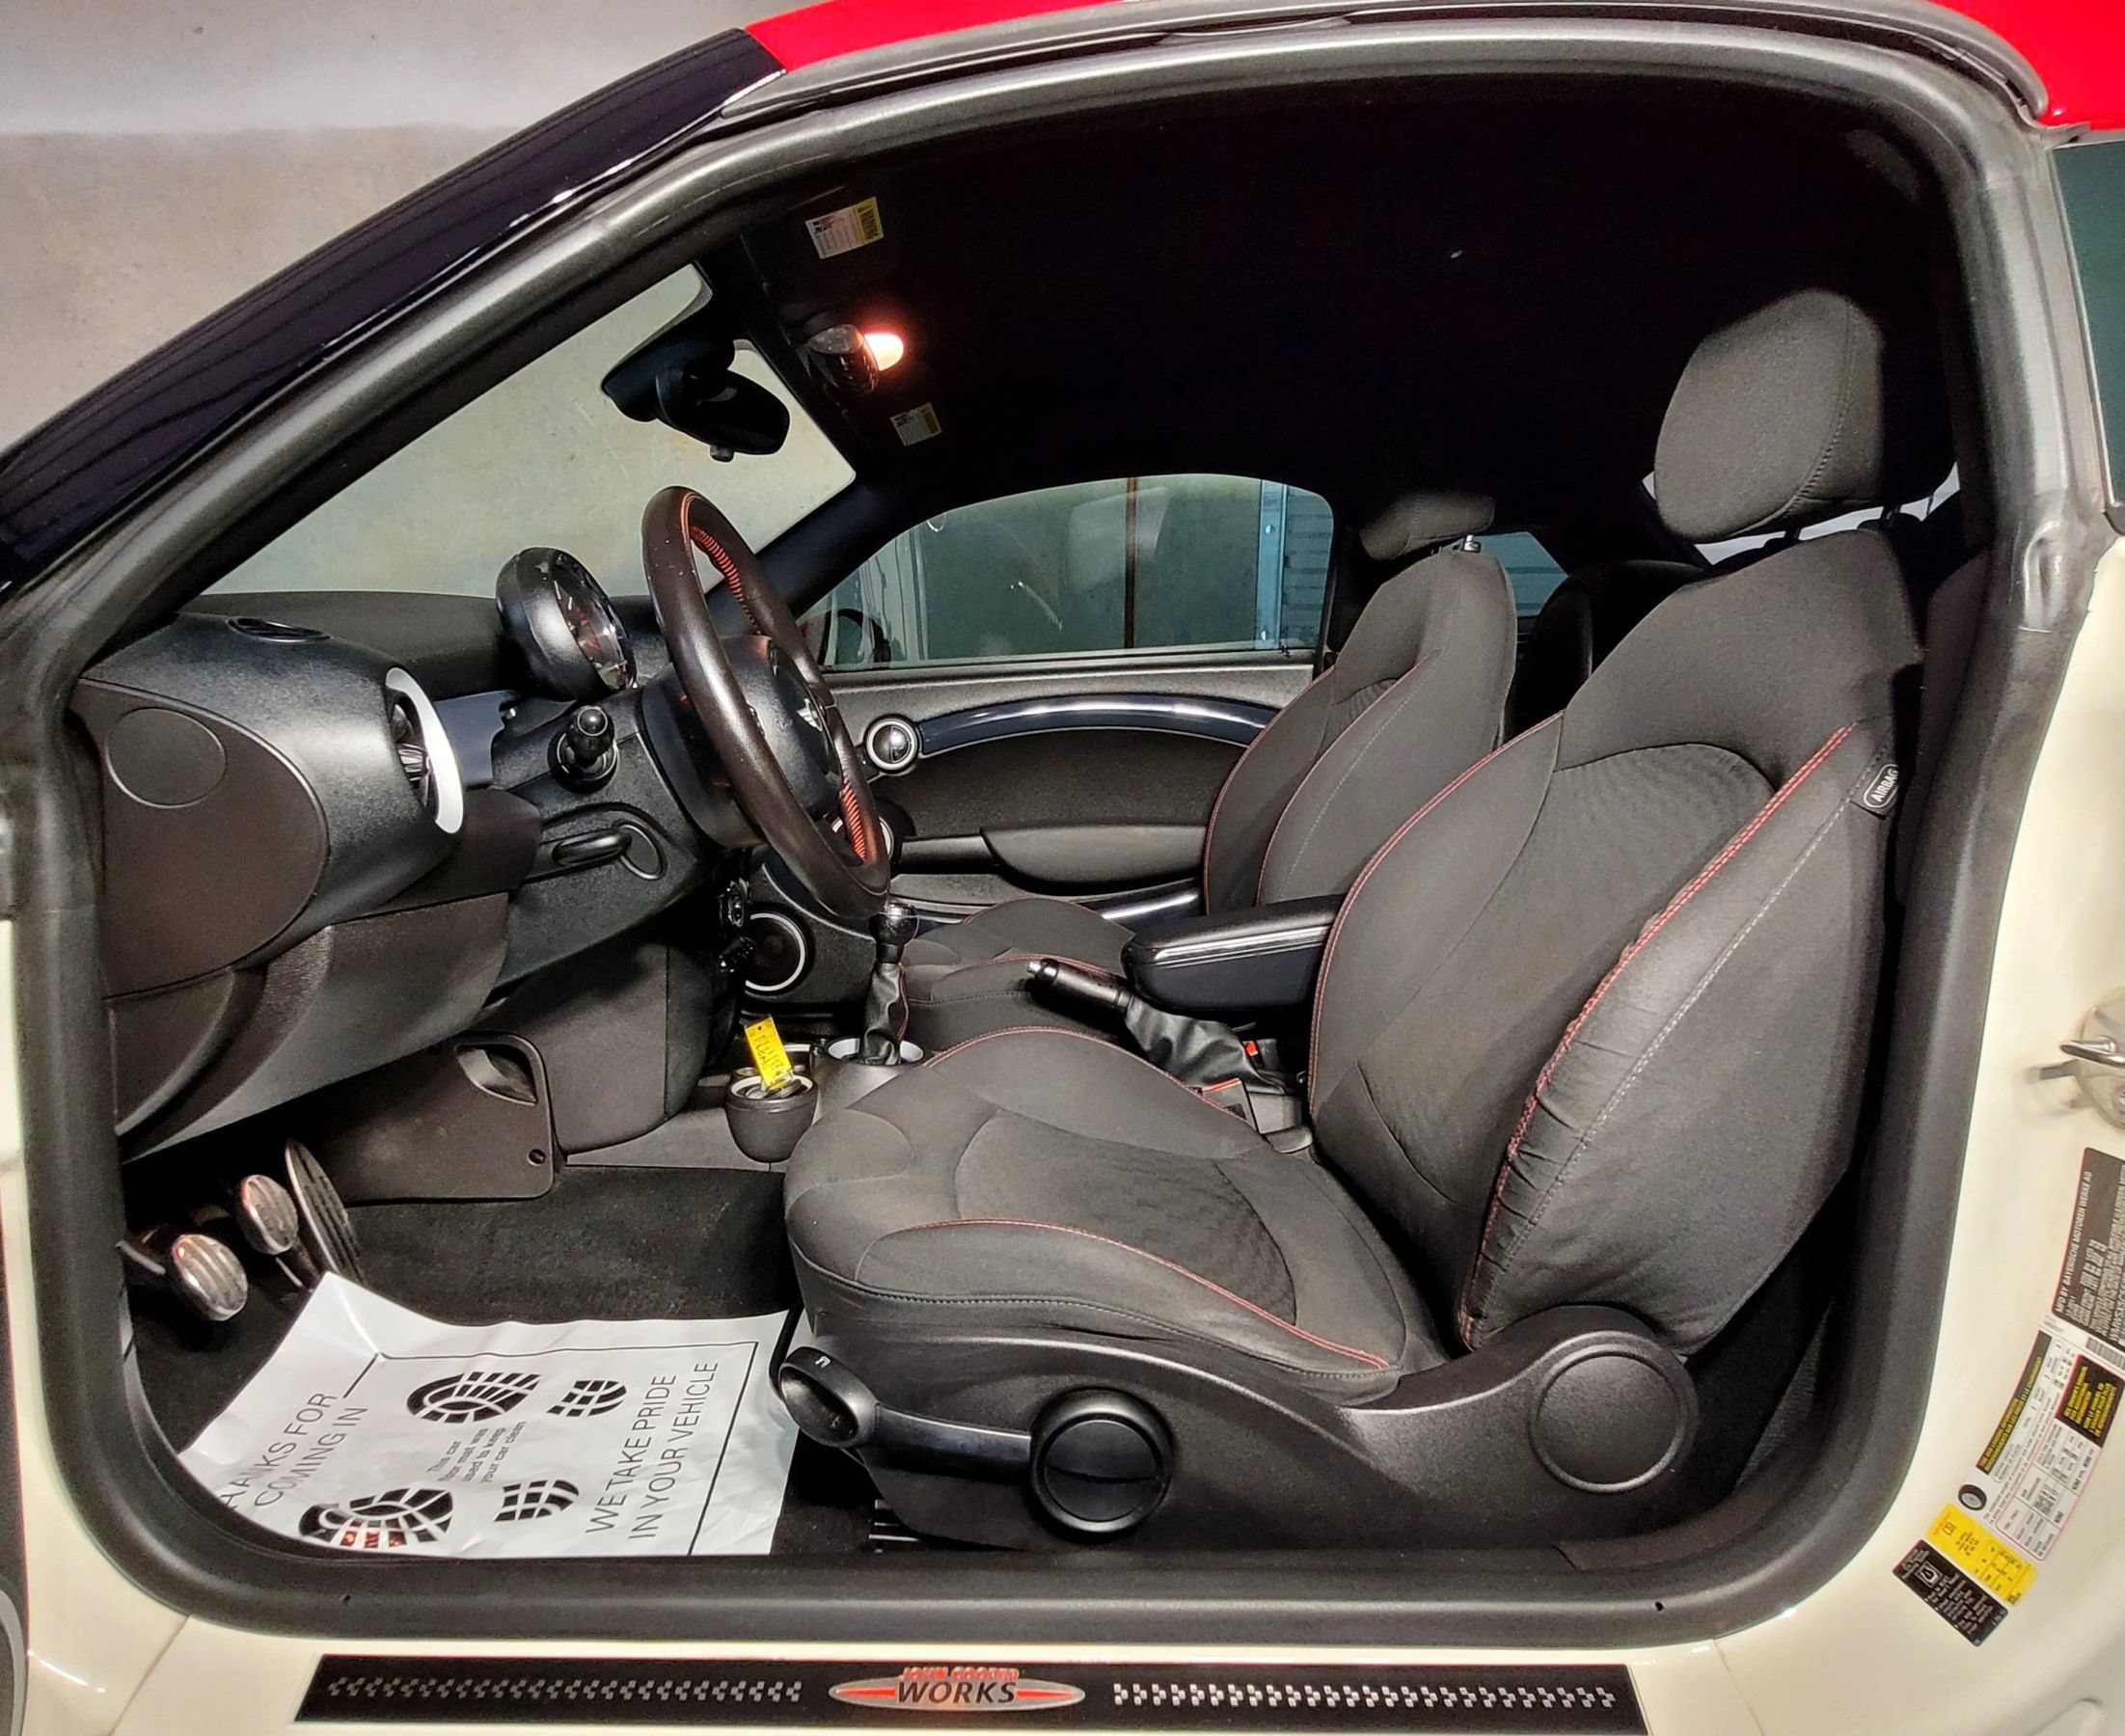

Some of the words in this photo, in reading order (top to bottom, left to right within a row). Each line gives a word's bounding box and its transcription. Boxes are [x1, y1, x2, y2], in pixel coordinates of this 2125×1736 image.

[1870, 769, 1898, 802] AIRBAG
[2072, 1206, 2085, 1242] MOTOREN
[632, 1375, 676, 1430] PRIDE
[667, 1363, 718, 1442] VEHICLE
[221, 1442, 297, 1508] HANKS
[284, 1394, 337, 1435] FOR
[254, 1433, 347, 1506] COMING
[333, 1408, 368, 1425] IN
[446, 1441, 461, 1454] car
[457, 1447, 476, 1463] mat
[471, 1428, 488, 1444] was
[461, 1461, 483, 1481] used
[483, 1427, 506, 1447] keep
[479, 1463, 500, 1483] your
[494, 1447, 509, 1460] car
[505, 1422, 527, 1443] clean
[605, 1437, 652, 1490] TAKE
[640, 1448, 689, 1508] YOUR
[586, 1494, 627, 1533] WE
[628, 1514, 664, 1539] IN
[898, 1681, 1017, 1703] WORKS
